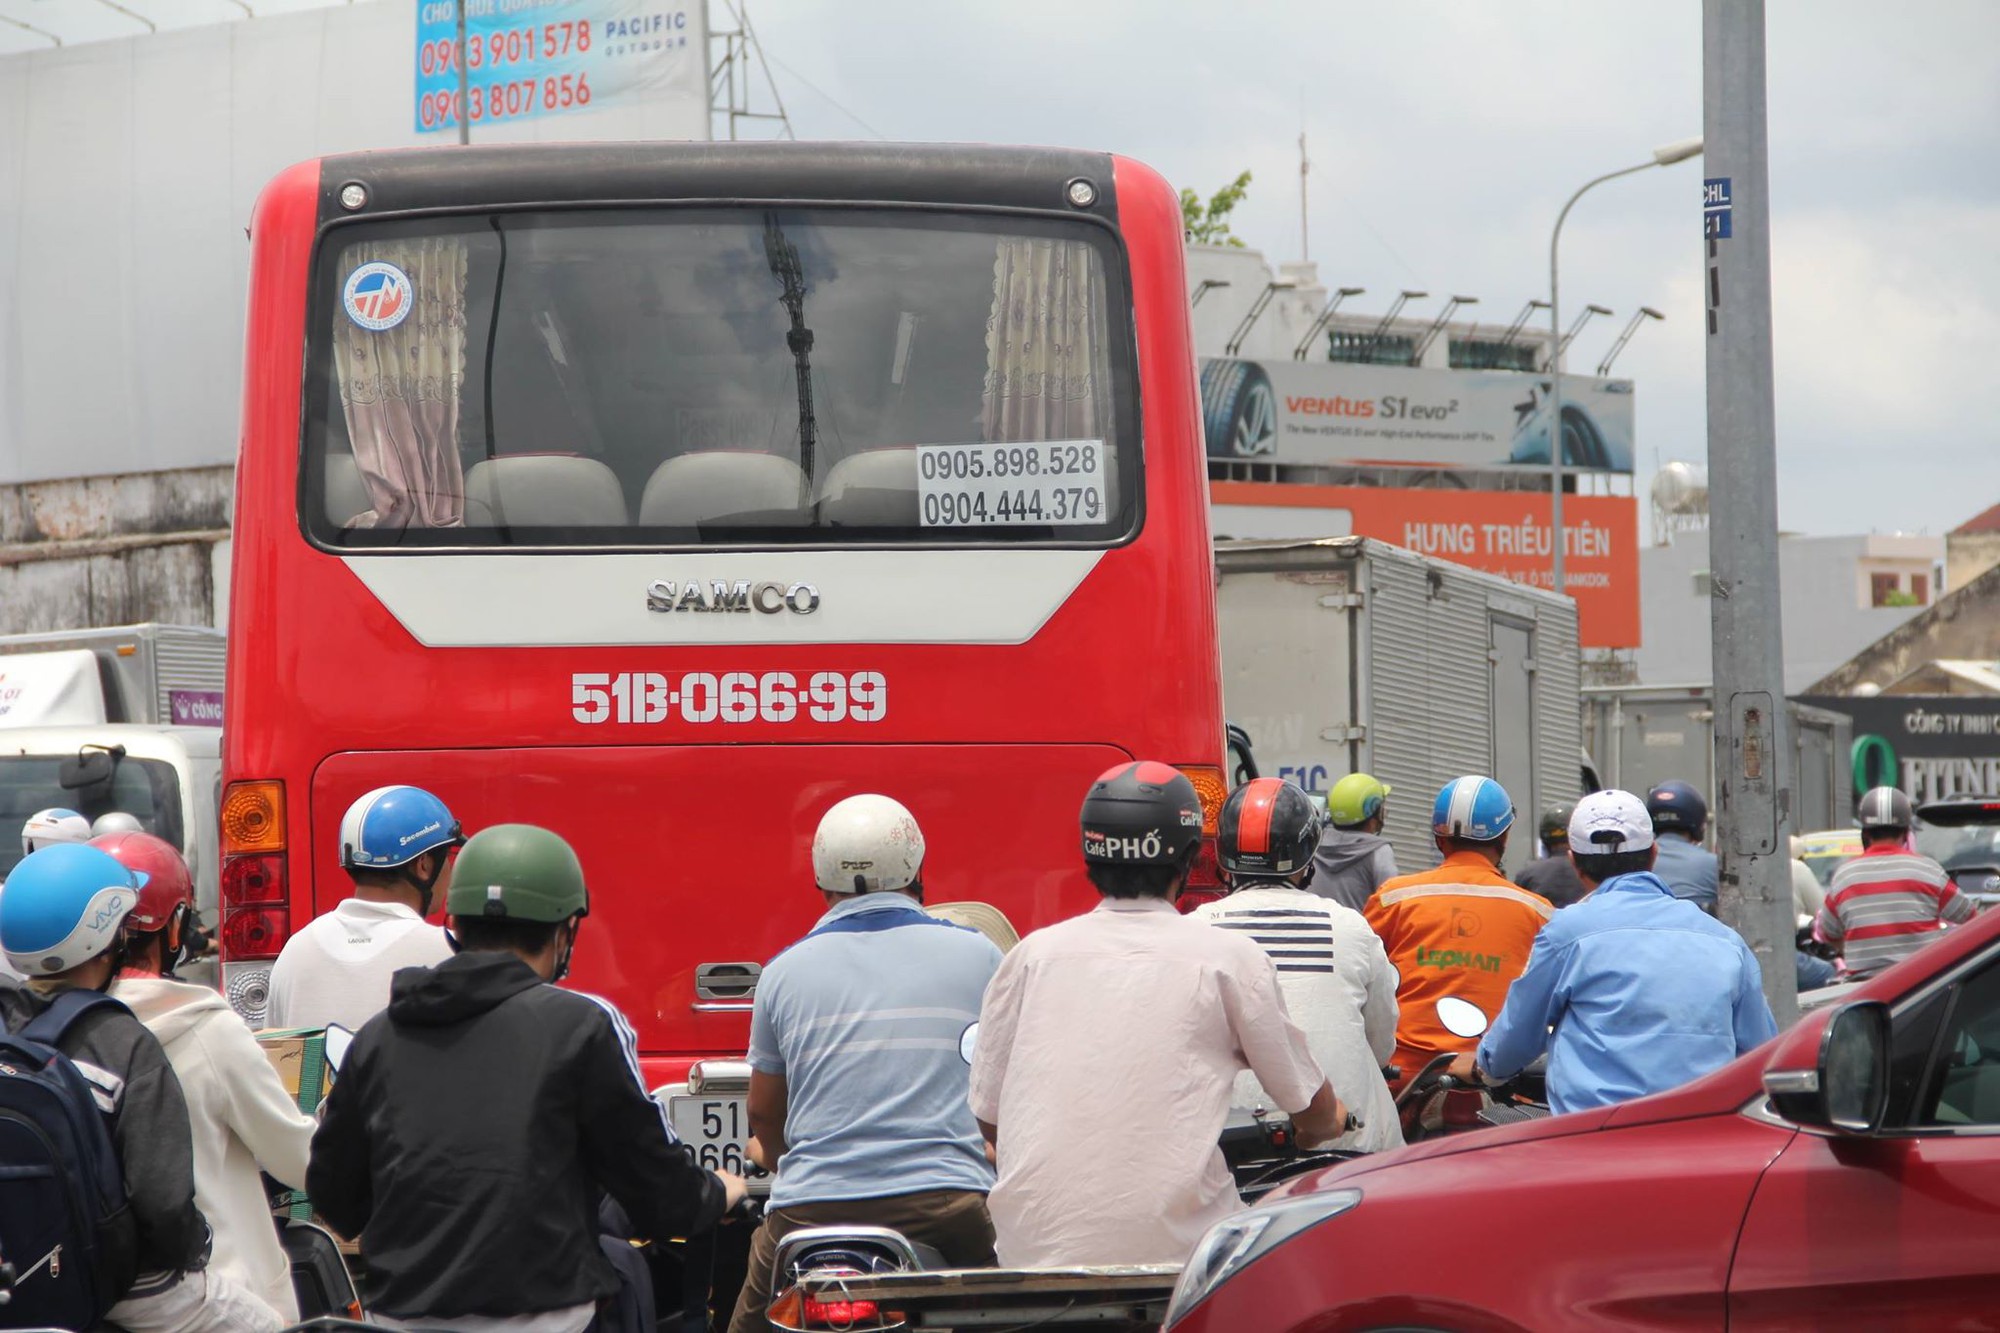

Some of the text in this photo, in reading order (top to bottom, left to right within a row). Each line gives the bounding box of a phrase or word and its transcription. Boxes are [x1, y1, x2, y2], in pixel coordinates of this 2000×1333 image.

[490, 27, 535, 65] 901
[543, 20, 591, 59] 578
[606, 12, 687, 38] PACIFIC
[605, 36, 688, 57] OUTDOOR
[490, 81, 536, 117] 807
[543, 72, 591, 111] 856
[1380, 396, 1406, 419] S1
[921, 446, 1096, 480] 0905.898.528
[925, 487, 1100, 525] 0904.444.379
[1404, 522, 1475, 555] HƯNG
[1563, 520, 1610, 557] TIÊN
[647, 578, 821, 614] SAMCO
[399, 821, 441, 847] Sacombank
[1084, 840, 1105, 858] Café
[1105, 829, 1162, 859] PHỐ
[703, 1102, 754, 1139] 51
